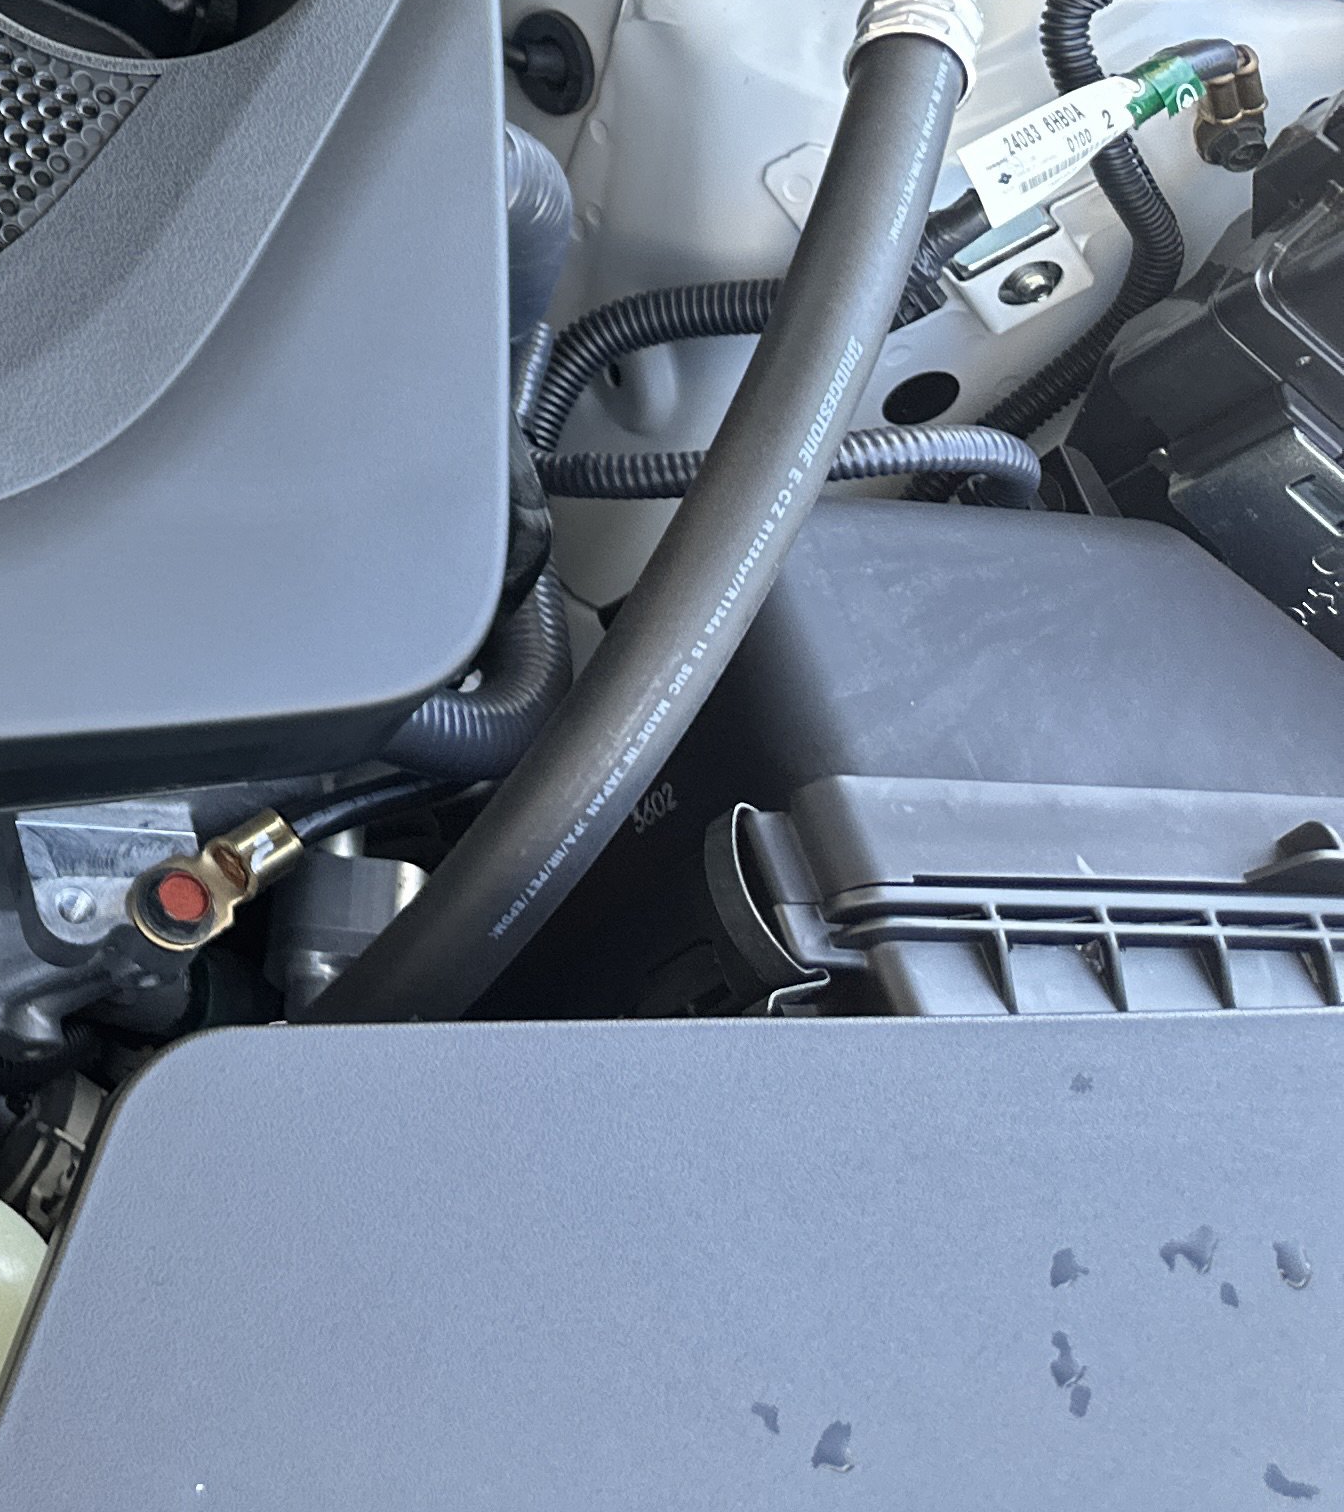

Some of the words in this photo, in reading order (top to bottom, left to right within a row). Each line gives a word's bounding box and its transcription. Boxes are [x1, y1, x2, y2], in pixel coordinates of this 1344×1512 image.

[921, 102, 937, 140] JAPAN
[1102, 109, 1114, 129] 2
[1003, 124, 1042, 155] 24083
[1067, 129, 1092, 153] 0100
[799, 336, 863, 468] BRIDGESTONE
[771, 467, 803, 519] E-CZ
[691, 640, 707, 660] 15
[668, 663, 693, 696] SUC
[637, 698, 671, 744] MADE
[622, 746, 641, 766] IN
[585, 767, 624, 817] JAPAN
